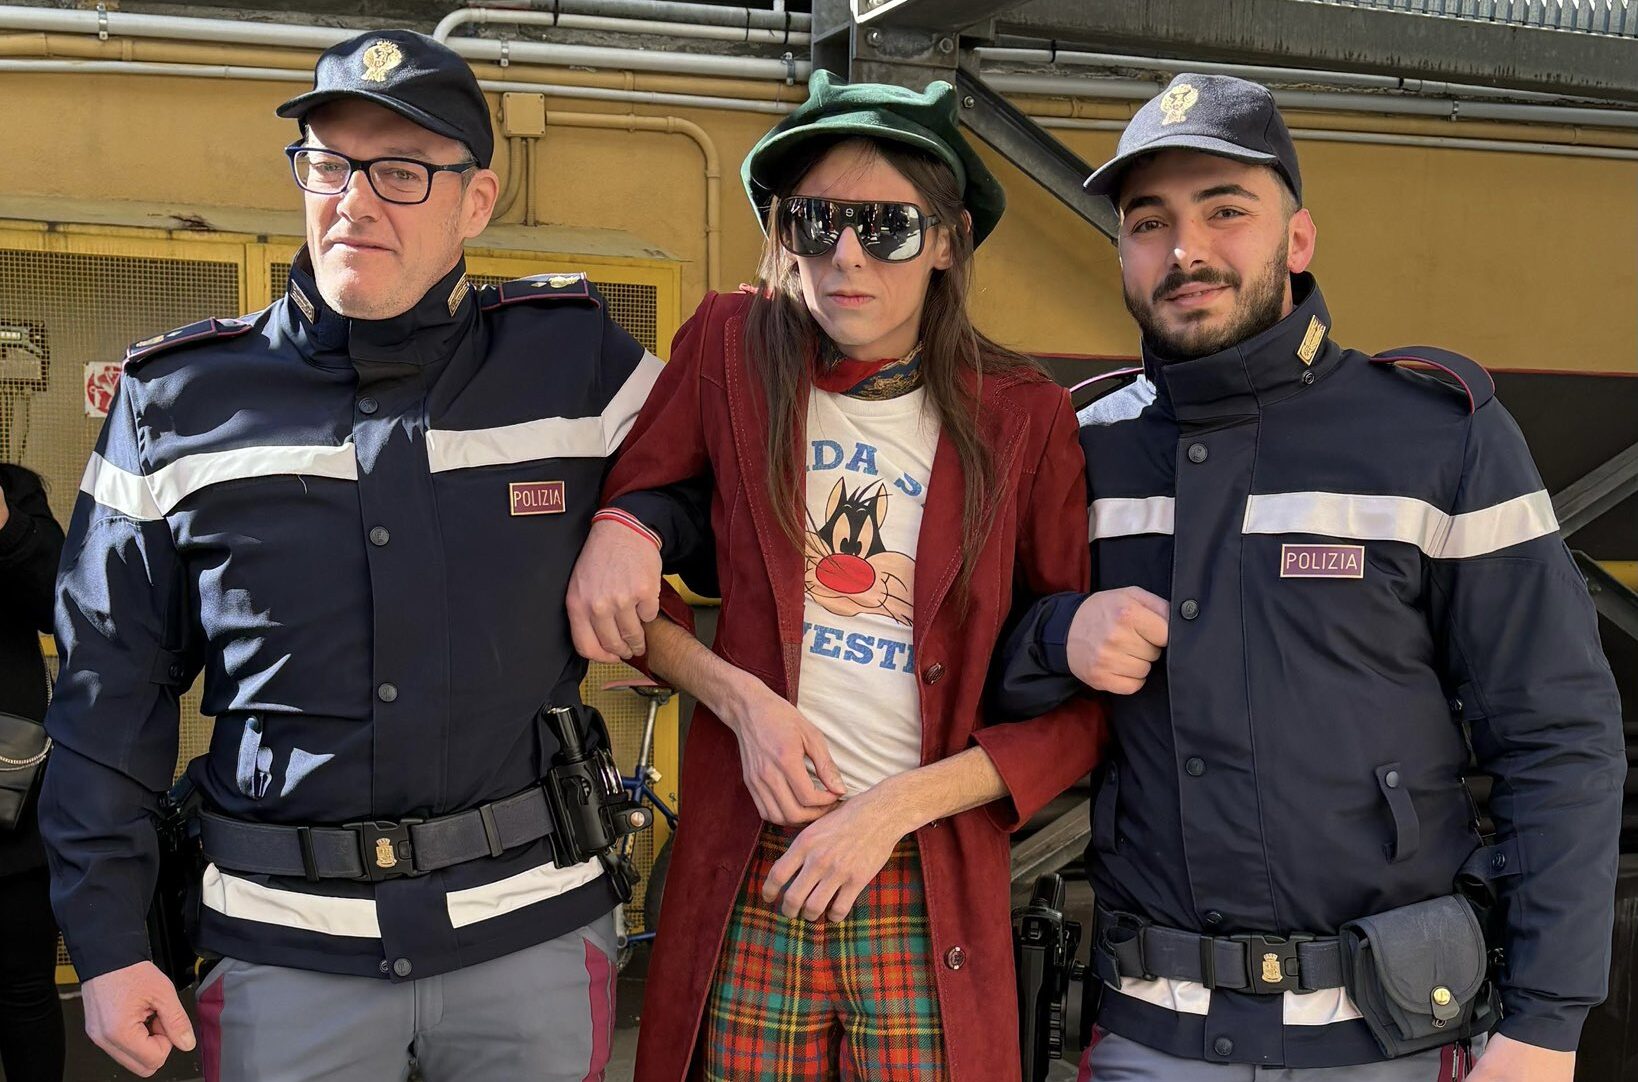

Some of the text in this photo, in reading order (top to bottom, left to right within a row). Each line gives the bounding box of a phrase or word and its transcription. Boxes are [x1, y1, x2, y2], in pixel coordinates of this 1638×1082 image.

[806, 440, 879, 476] DA
[513, 488, 562, 508] POLIZIA
[1286, 552, 1358, 570] POLIZIA
[803, 621, 914, 674] EST
